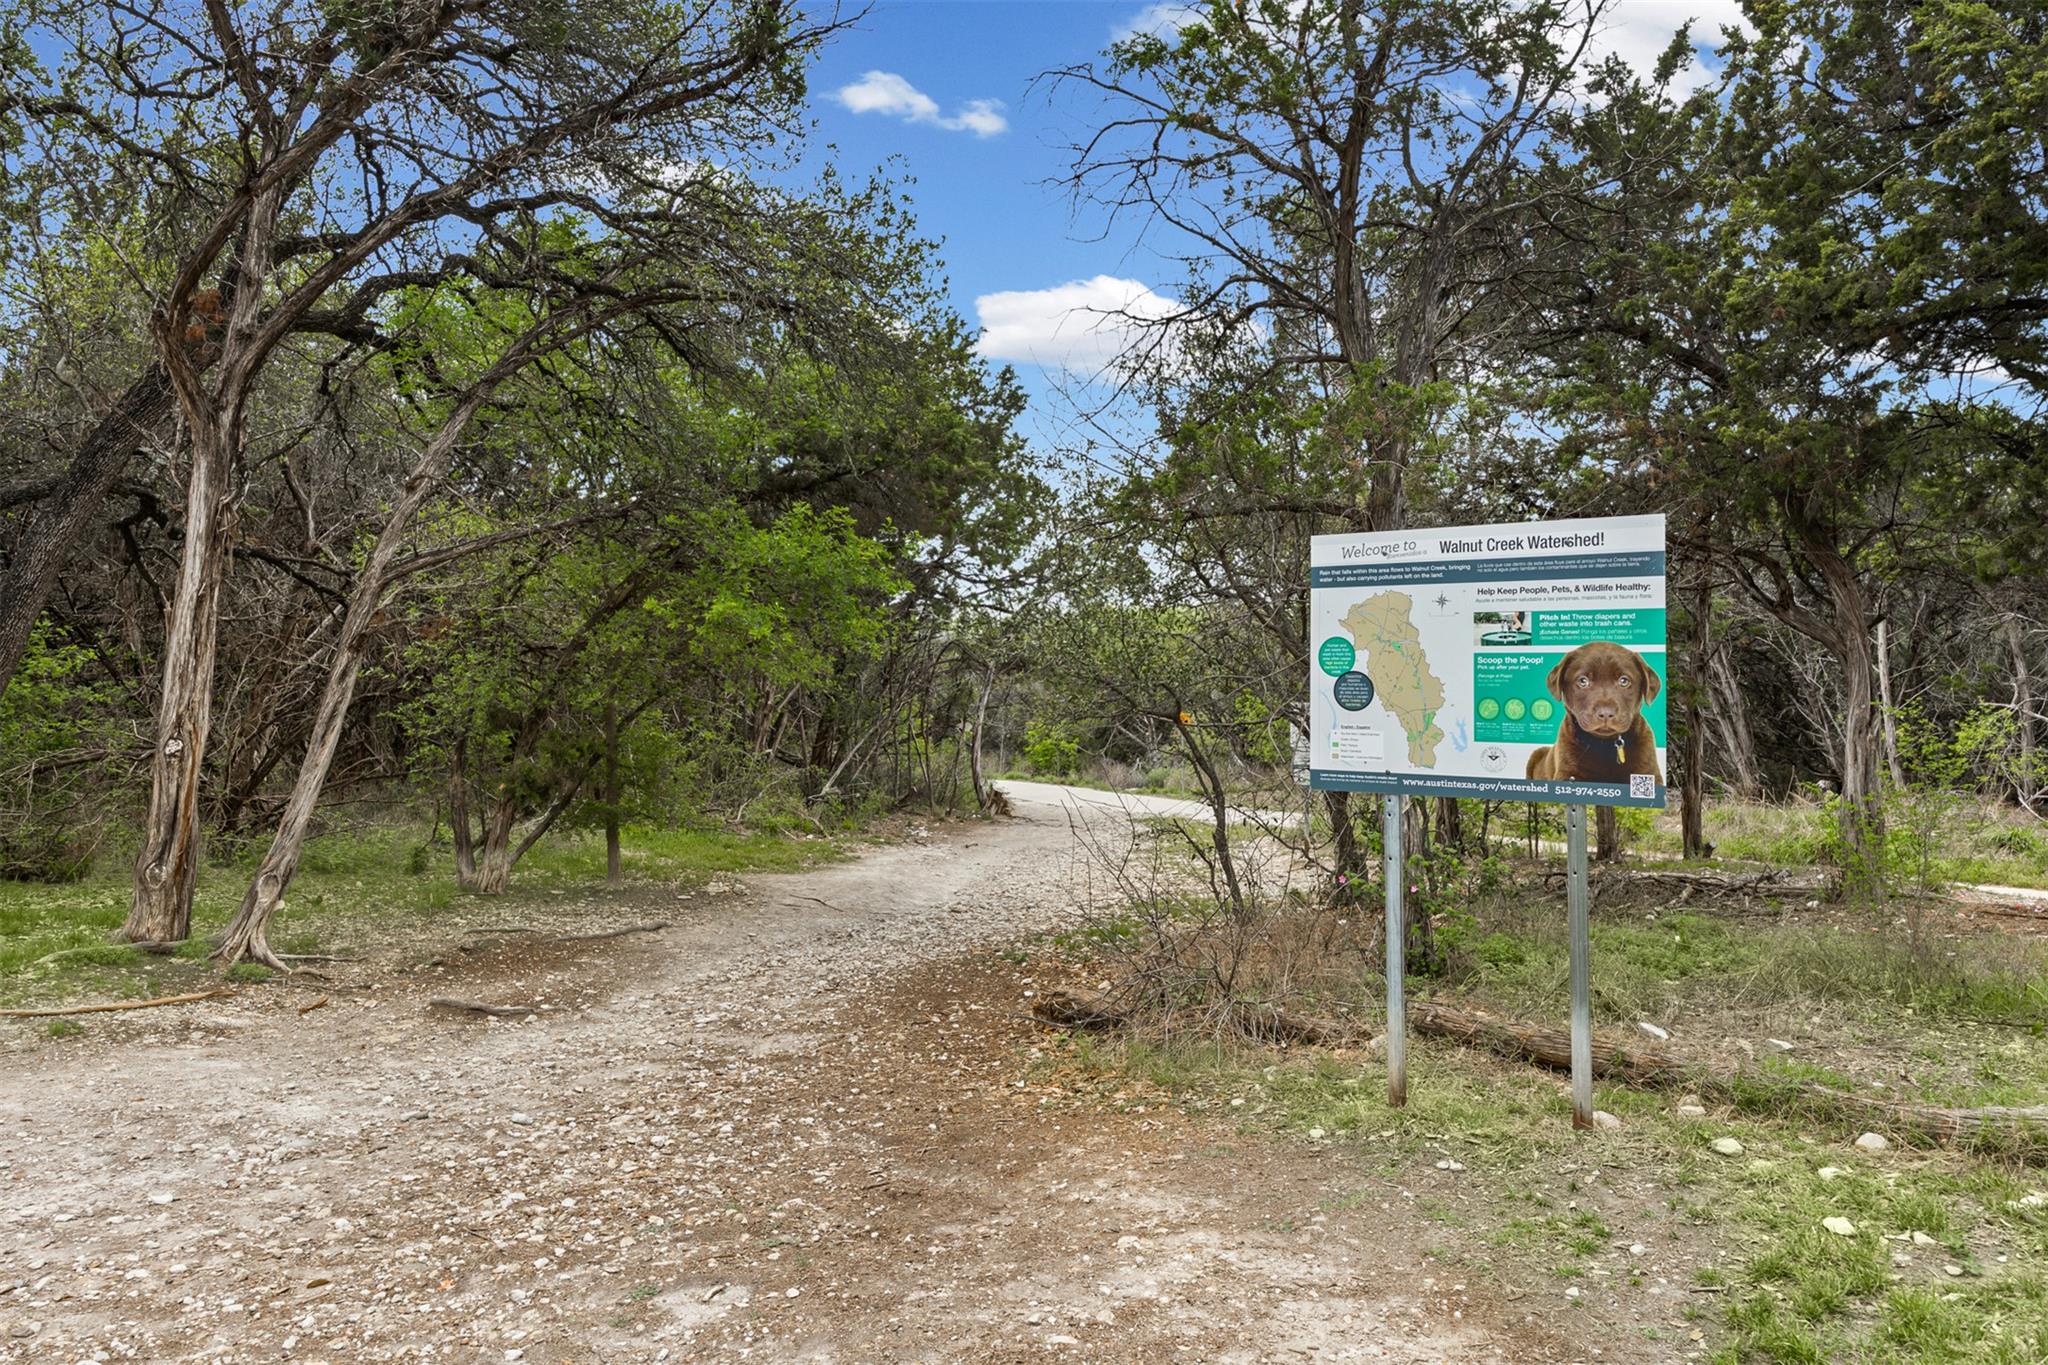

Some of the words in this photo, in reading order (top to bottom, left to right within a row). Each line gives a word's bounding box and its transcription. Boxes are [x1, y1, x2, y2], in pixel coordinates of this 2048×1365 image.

[1341, 543, 1400, 559] Welcome
[1404, 540, 1417, 551] to
[1440, 539, 1483, 554] Walnut
[1487, 536, 1524, 552] Creek
[1527, 532, 1605, 549] Watershed!
[1497, 587, 1518, 595] Keep
[1520, 586, 1550, 594] People,
[1552, 585, 1572, 593] Pets,
[1583, 584, 1613, 592] Wildlife
[1616, 583, 1651, 592] Healthy:
[1504, 656, 1518, 664] the
[1520, 656, 1544, 664] Poop!
[1402, 779, 1548, 792] www.austintexas.gov/watershed
[1555, 786, 1621, 798] 512-974-2550
